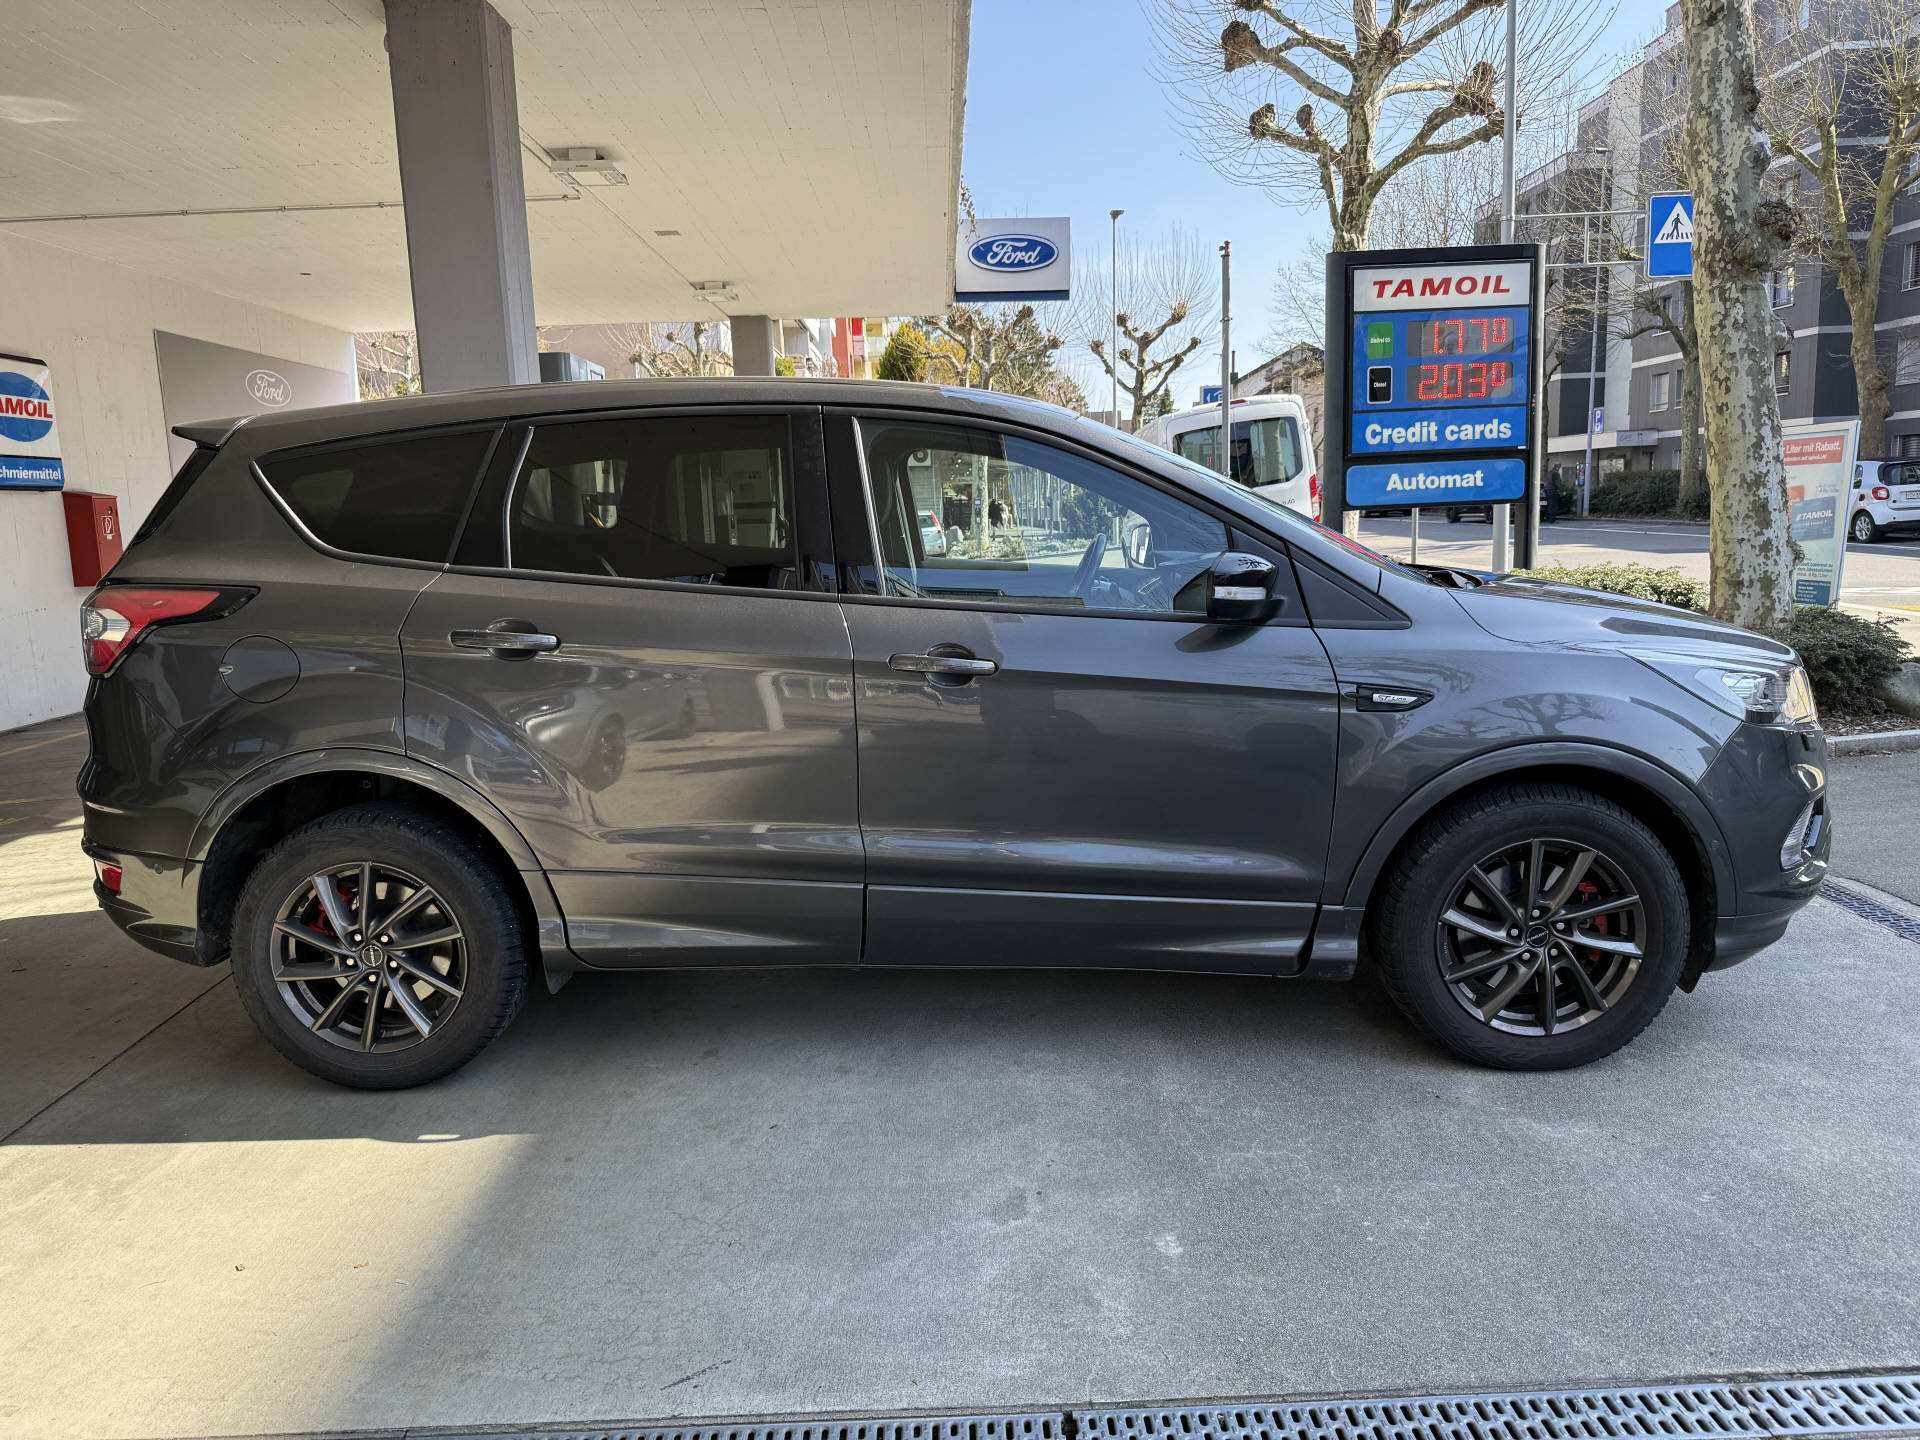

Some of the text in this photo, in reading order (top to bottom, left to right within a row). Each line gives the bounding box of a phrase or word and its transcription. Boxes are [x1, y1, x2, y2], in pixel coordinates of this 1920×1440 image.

[987, 240, 1041, 264] Ford
[1373, 275, 1511, 298] TAMOIL
[254, 373, 285, 401] Ford
[1365, 418, 1512, 445] Credit cards
[1786, 444, 1802, 454] Liter
[1802, 443, 1814, 453] mit
[1386, 470, 1484, 492] Automat
[1802, 509, 1833, 521] TAMOIL
